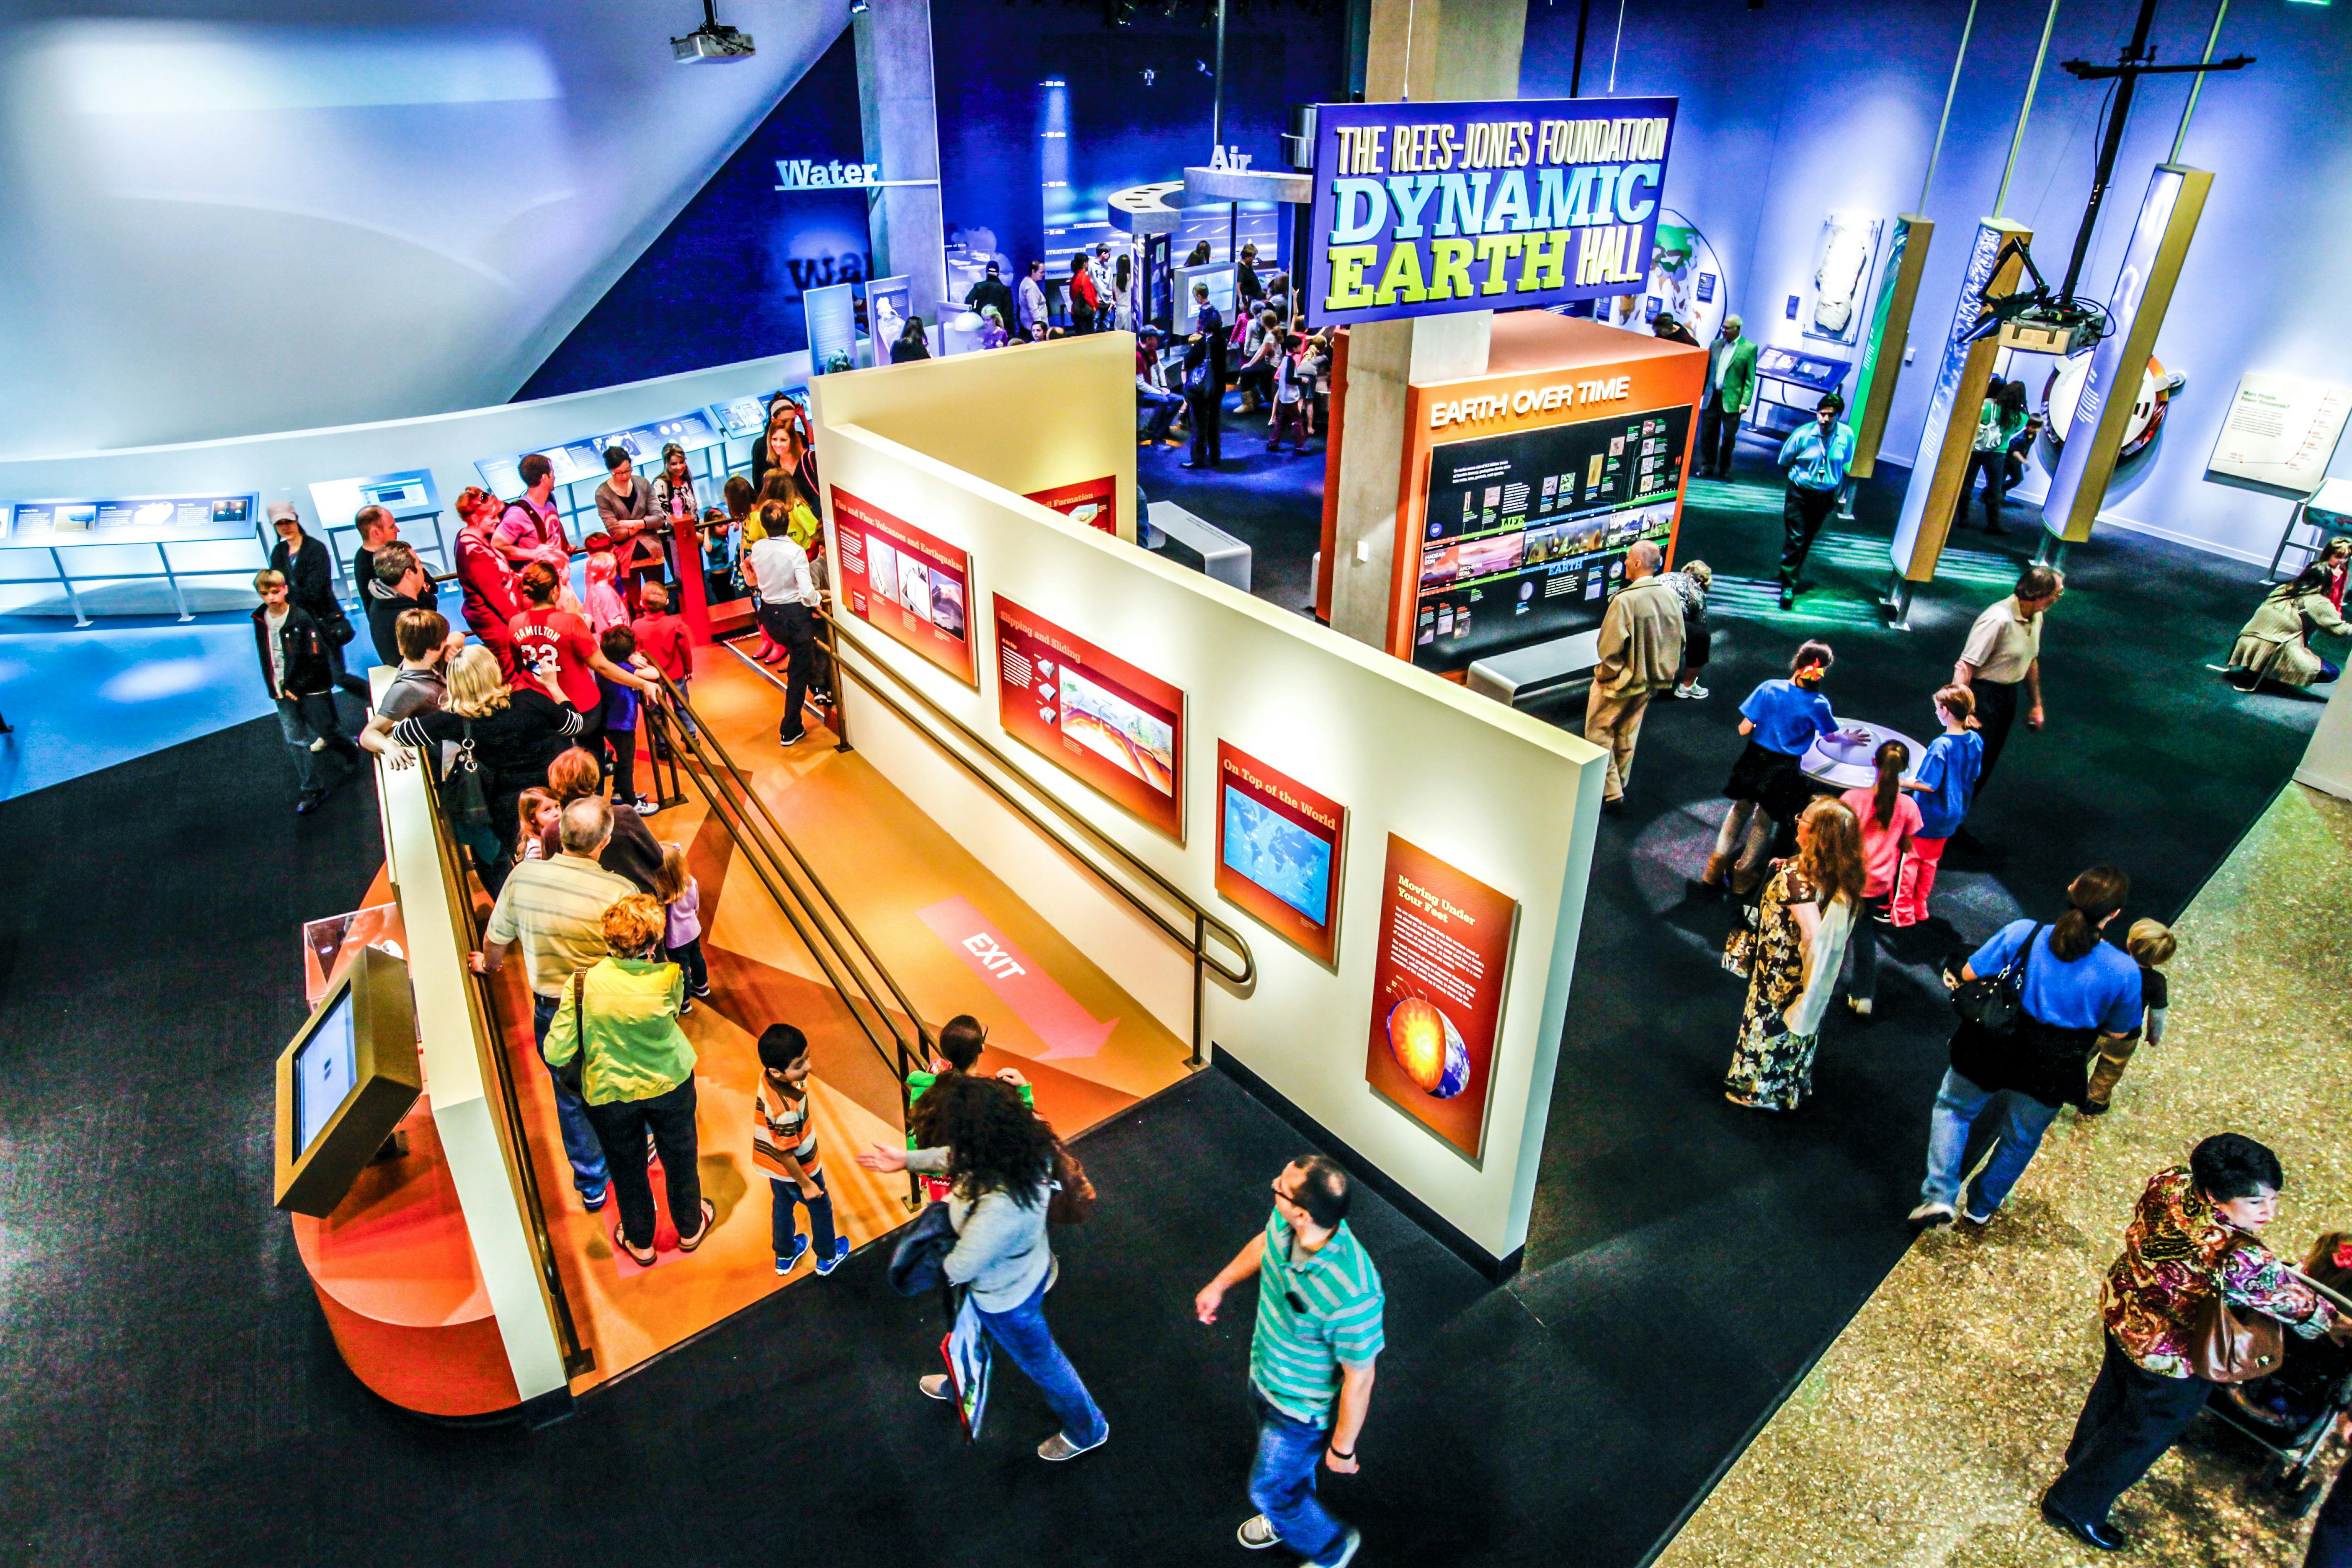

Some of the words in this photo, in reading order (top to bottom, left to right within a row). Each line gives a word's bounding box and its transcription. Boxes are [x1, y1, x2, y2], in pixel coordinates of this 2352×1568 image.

[1210, 145, 1252, 174] Air
[1337, 126, 1386, 174] THE
[1392, 121, 1533, 173] REES-JONES
[1536, 118, 1669, 165] FOUNDATION
[776, 160, 877, 186] Water
[1330, 163, 1660, 245] DYNAMIC
[1325, 230, 1571, 310] EARTH
[1575, 225, 1643, 286] HALL
[1431, 393, 1507, 427] EARTH
[1513, 384, 1573, 414] OVER
[1578, 377, 1631, 404] TIME
[2259, 400, 2290, 409] Resources?
[1054, 493, 1093, 507] Formation
[835, 498, 846, 513] Fire
[848, 506, 858, 518] and
[859, 511, 874, 526] Flux:
[875, 520, 906, 542] Volcanoes
[907, 536, 920, 549] and
[920, 543, 964, 573] Earthquakes
[1501, 514, 1526, 529] LIFE
[1525, 529, 1557, 538] PROTEROZOIC
[1609, 529, 1640, 539] PHANEROZOIC
[1424, 552, 1446, 560] HADEAN
[1459, 563, 1483, 572] ARCHEAN
[1548, 560, 1584, 576] EARTH
[514, 625, 561, 642] HAMILTON
[1001, 611, 1032, 637] Slipping
[1034, 629, 1050, 647] and
[1051, 637, 1081, 664] Sliding
[1224, 758, 1239, 776] On
[1242, 767, 1263, 790] Top
[1265, 783, 1277, 797] of
[1279, 790, 1298, 809] the
[1300, 801, 1336, 831] World
[1398, 874, 1439, 906] Moving
[1441, 899, 1476, 926] Under
[1398, 886, 1423, 908] Your
[1424, 901, 1449, 923] Feet
[962, 932, 1026, 979] EXIT
